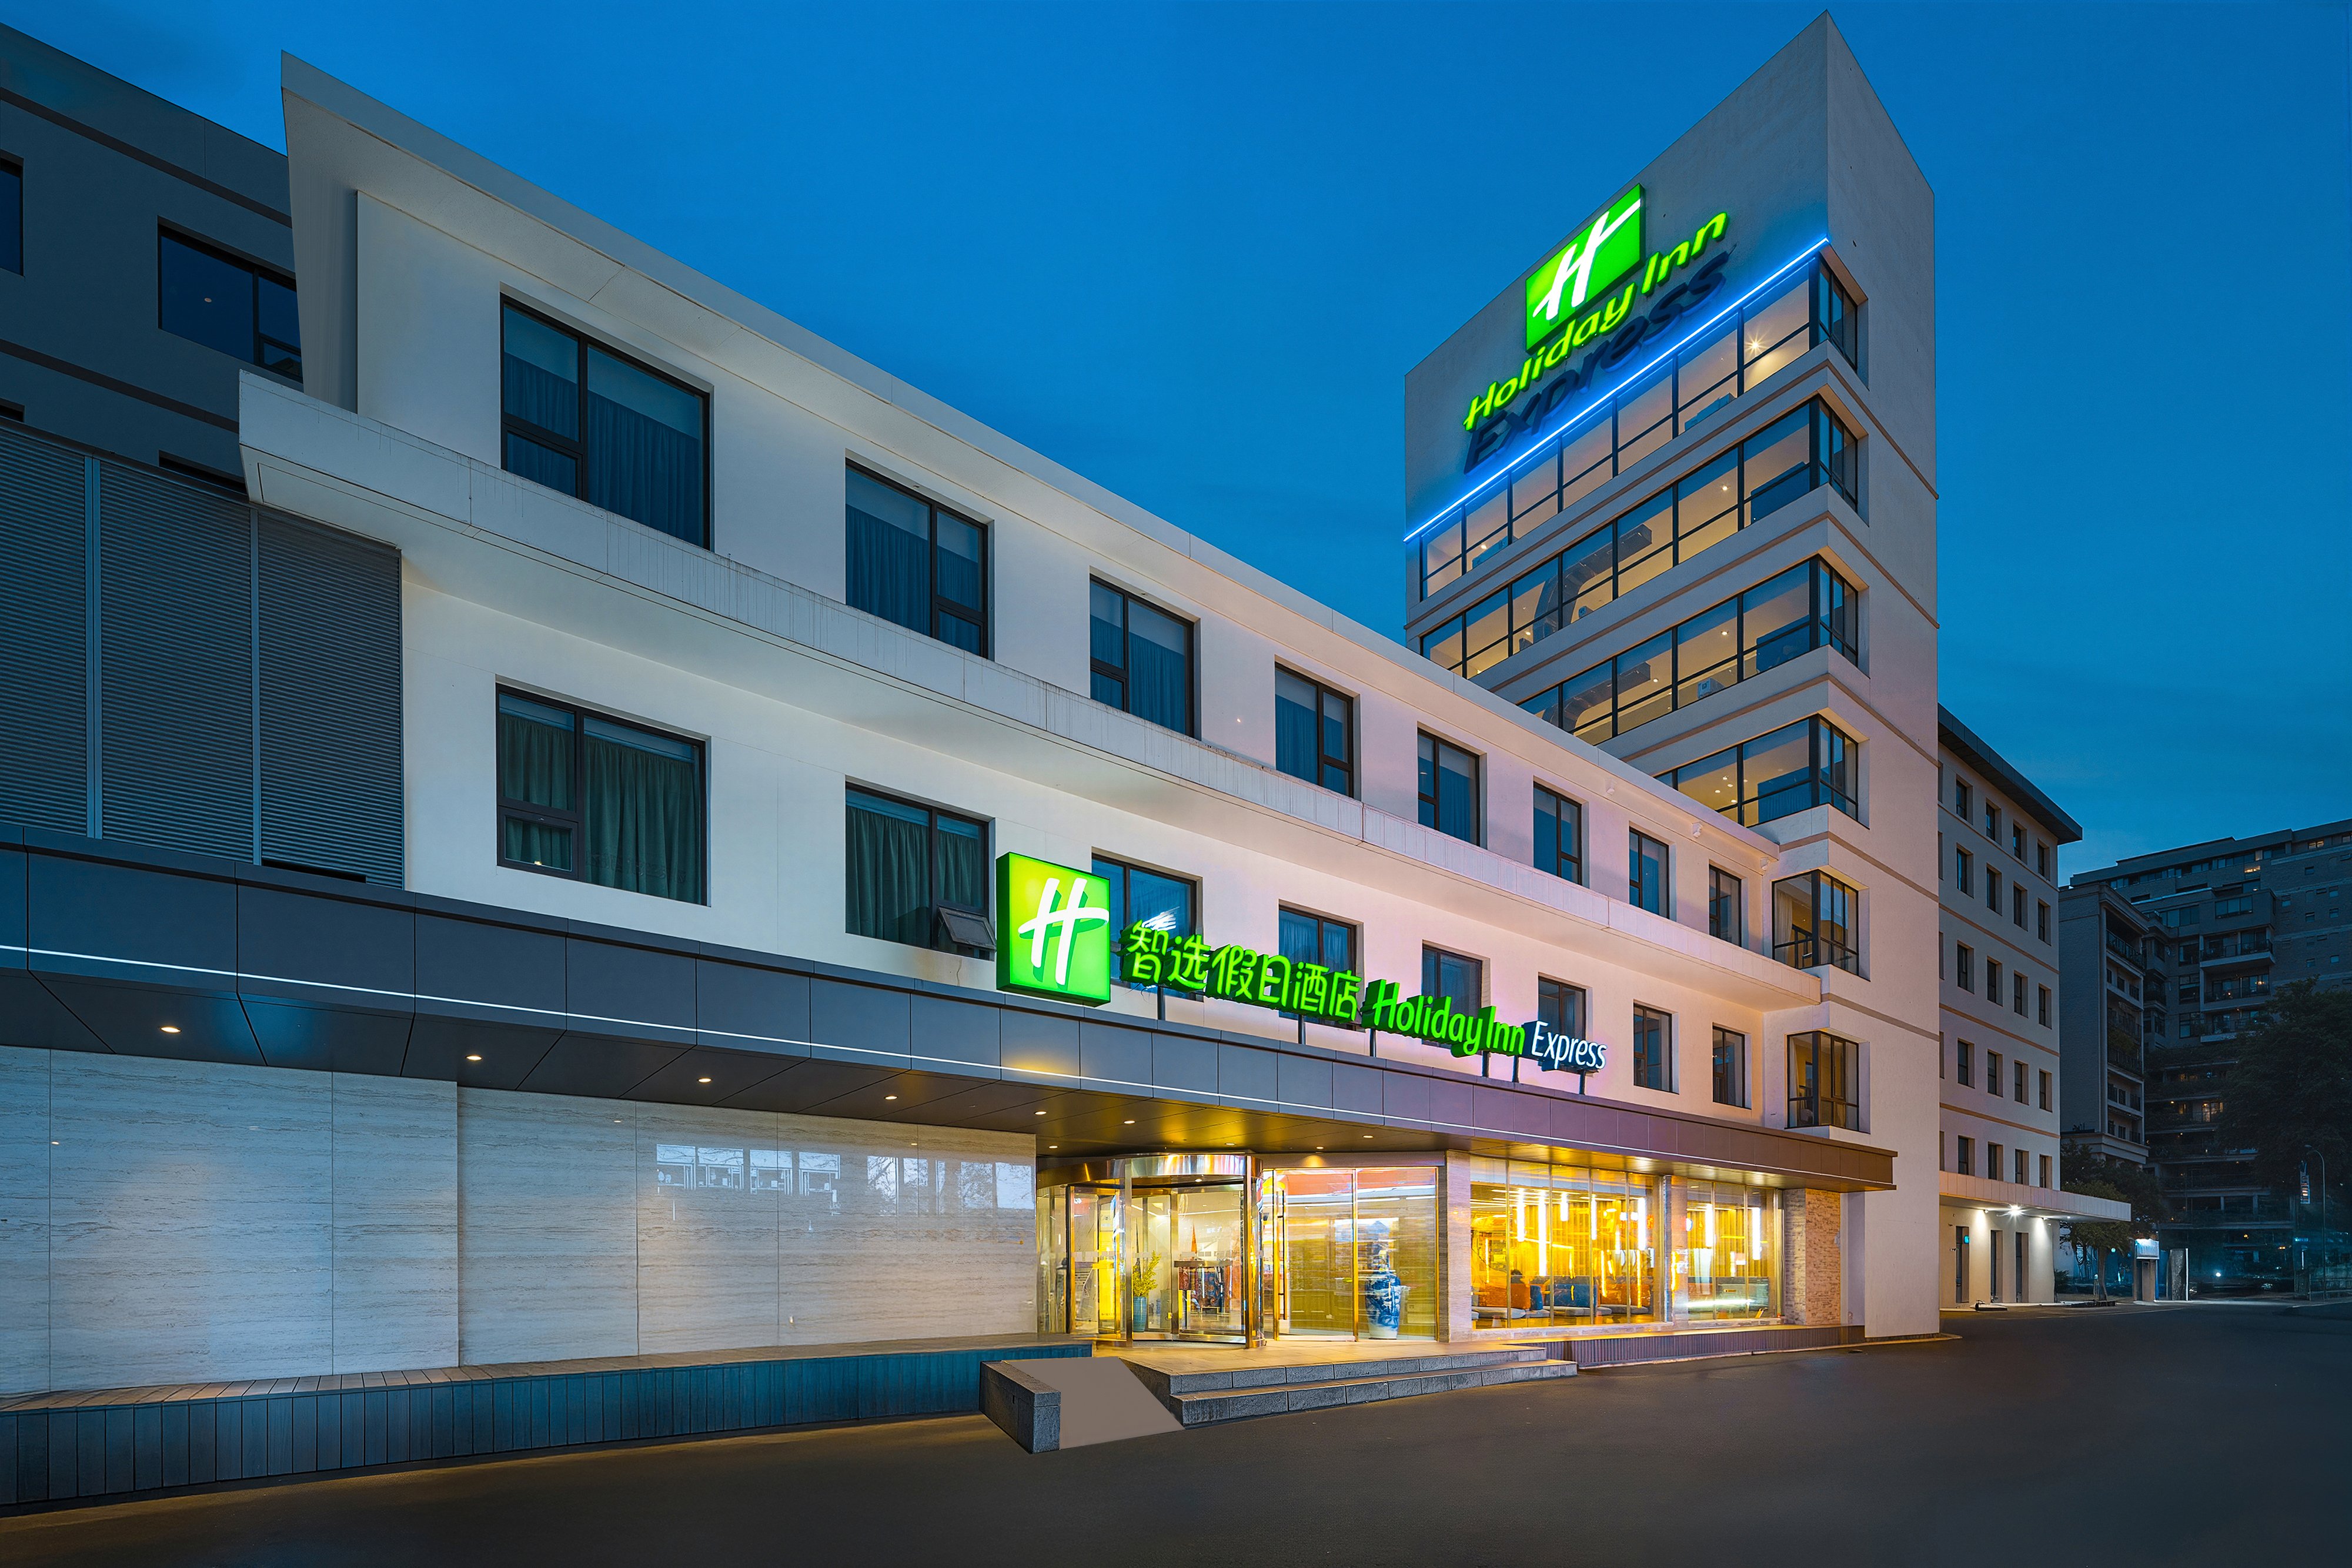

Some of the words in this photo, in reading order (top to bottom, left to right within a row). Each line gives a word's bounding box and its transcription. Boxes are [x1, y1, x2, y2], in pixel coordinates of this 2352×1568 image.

[1462, 282, 1636, 431] Holiday
[1642, 212, 1728, 295] Inn
[1464, 250, 1729, 474] Express
[1125, 920, 1362, 1022] 智选假日酒店
[1372, 979, 1484, 1055] Holiday
[1486, 1005, 1526, 1055] Inn
[1531, 1020, 1608, 1069] Express
